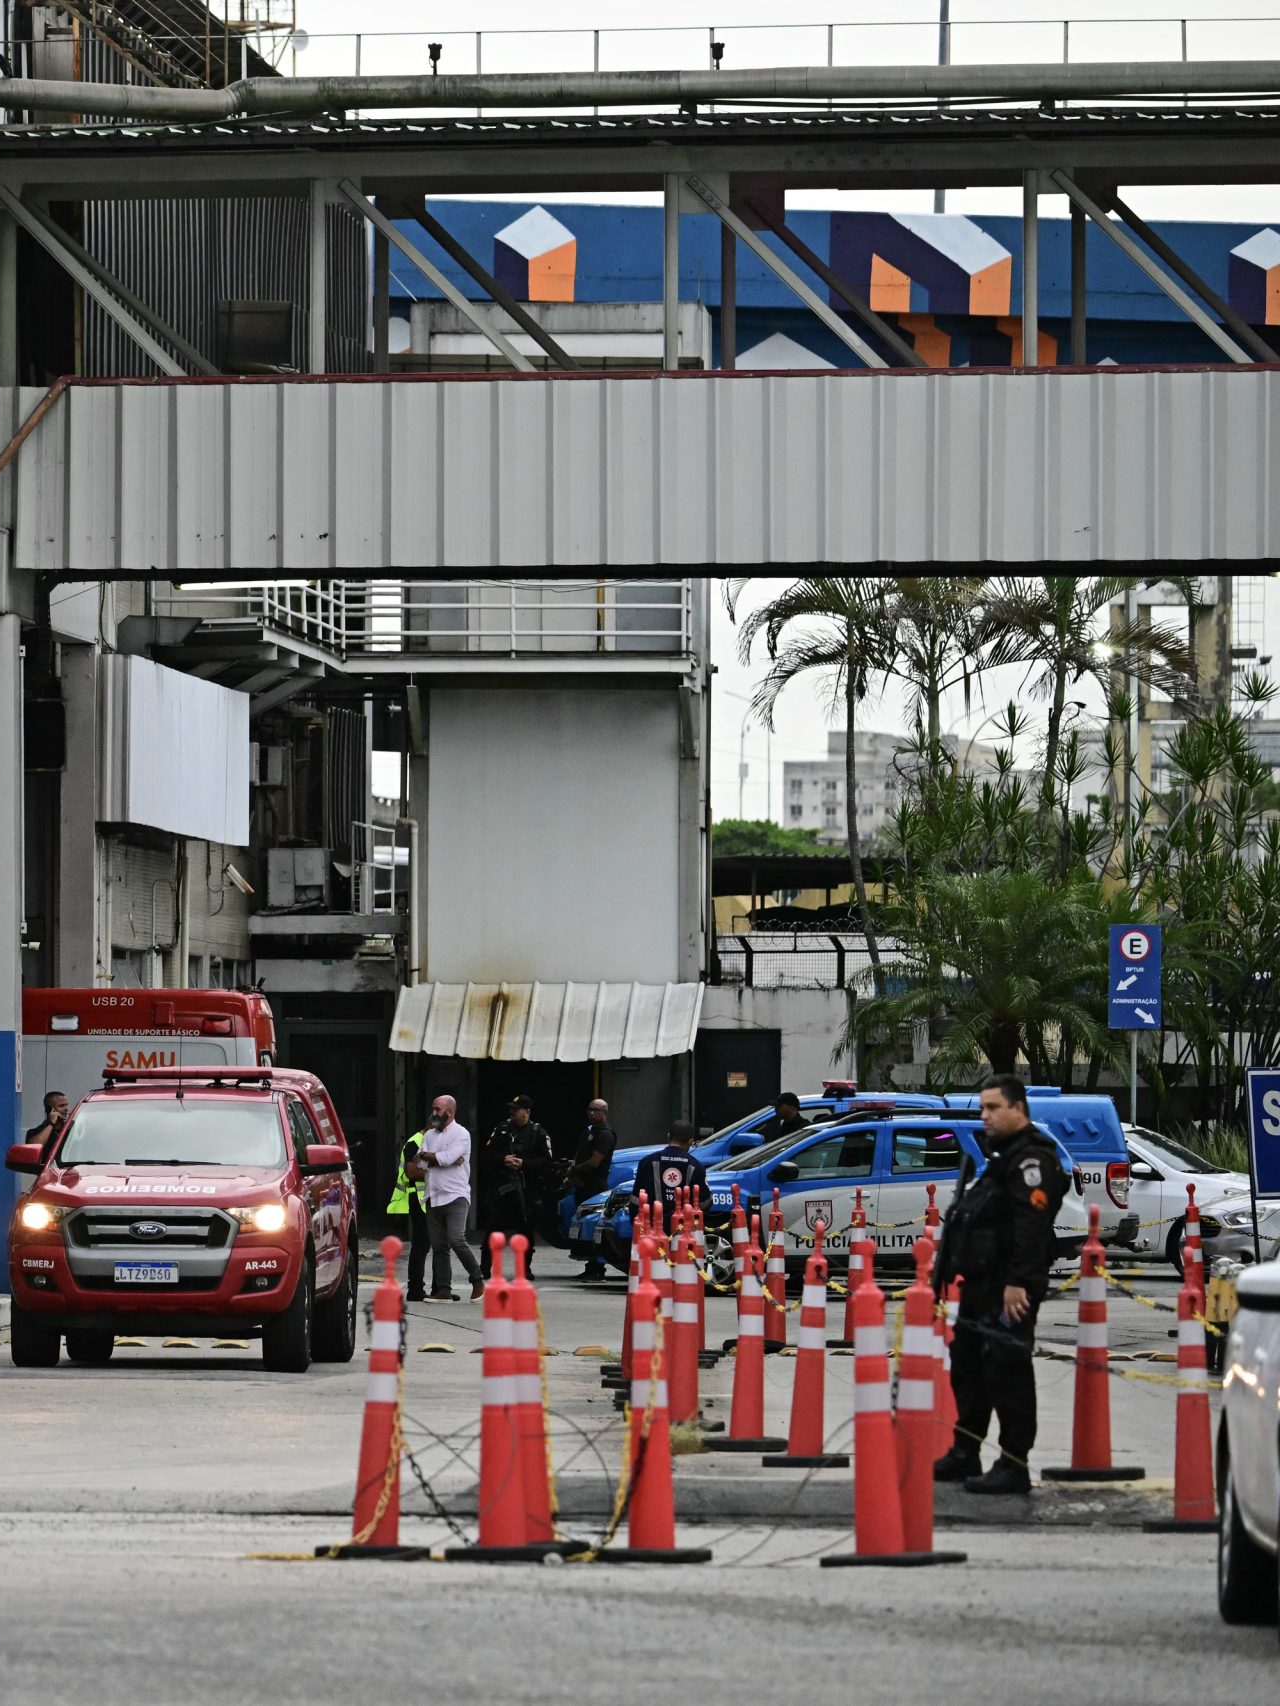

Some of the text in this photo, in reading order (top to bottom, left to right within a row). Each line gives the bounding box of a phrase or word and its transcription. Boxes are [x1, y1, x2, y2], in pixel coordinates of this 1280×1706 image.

[1129, 938, 1142, 955] E
[92, 997, 135, 1006] USB 20
[171, 1027, 200, 1036] BÁSICO
[105, 1050, 176, 1069] SAMU
[712, 1193, 733, 1205] 698
[22, 1258, 55, 1269] CBMERJ
[245, 1260, 277, 1270] AR-443
